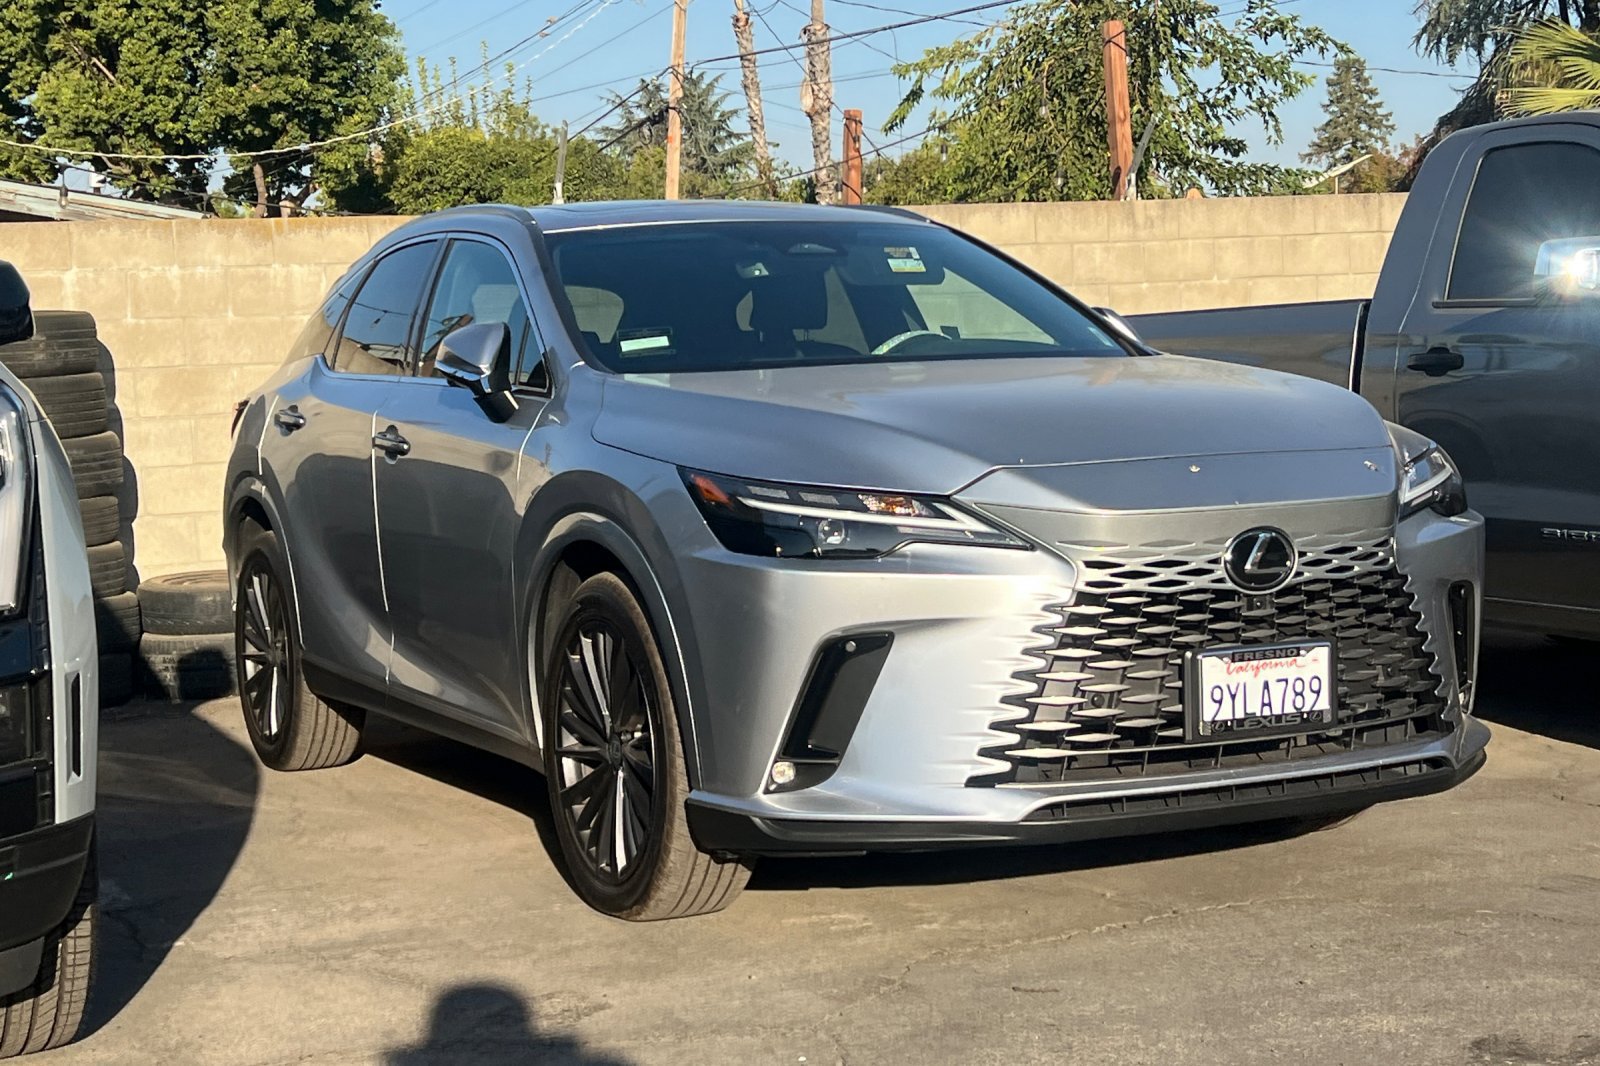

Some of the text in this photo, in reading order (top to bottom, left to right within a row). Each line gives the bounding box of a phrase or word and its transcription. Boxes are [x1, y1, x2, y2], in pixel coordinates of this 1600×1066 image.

[1234, 648, 1298, 661] FRESNO
[1226, 658, 1305, 678] California
[1211, 675, 1322, 721] 9YLA789
[1233, 713, 1302, 731] LEXUS
